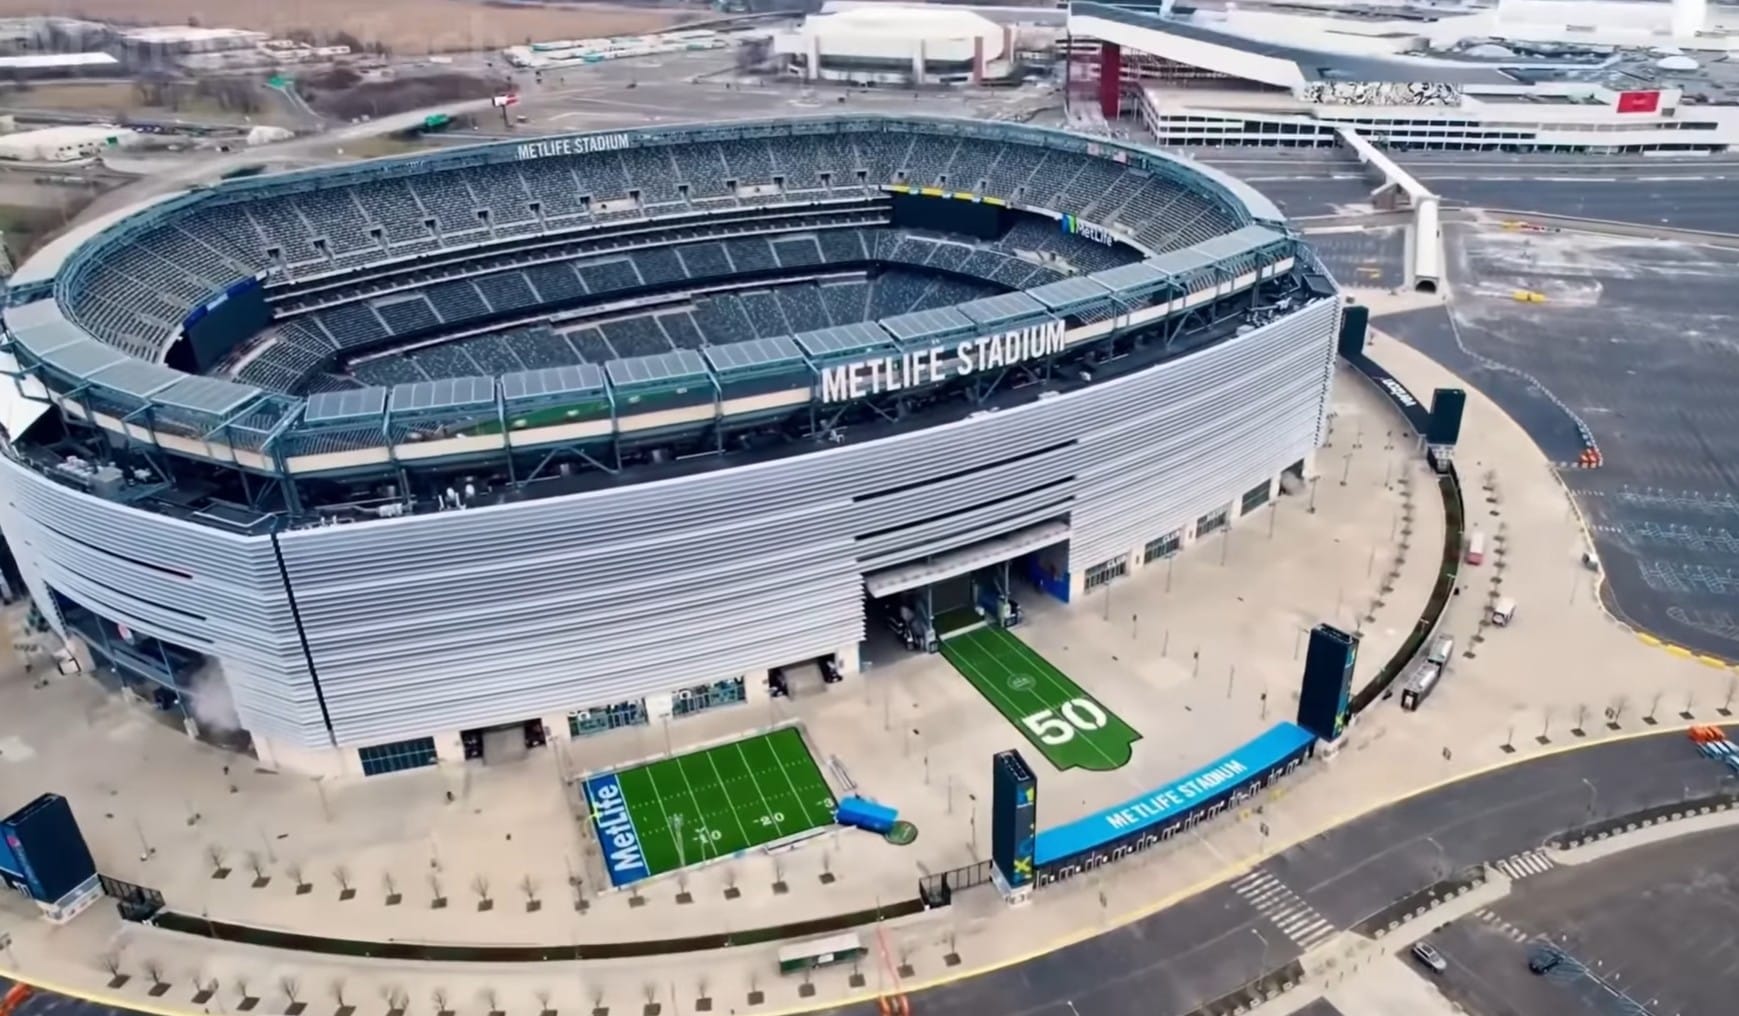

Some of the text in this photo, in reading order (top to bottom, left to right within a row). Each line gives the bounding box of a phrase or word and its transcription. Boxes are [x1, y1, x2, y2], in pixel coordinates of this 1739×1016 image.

[517, 134, 629, 160] METLIFE STADIUM
[1075, 219, 1113, 247] MetLife
[822, 319, 1066, 404] METLIFE STADIUM
[1021, 698, 1107, 745] 50
[1105, 759, 1248, 829] METLIFE STADIUM
[596, 784, 644, 871] MetLife
[759, 812, 785, 827] 20
